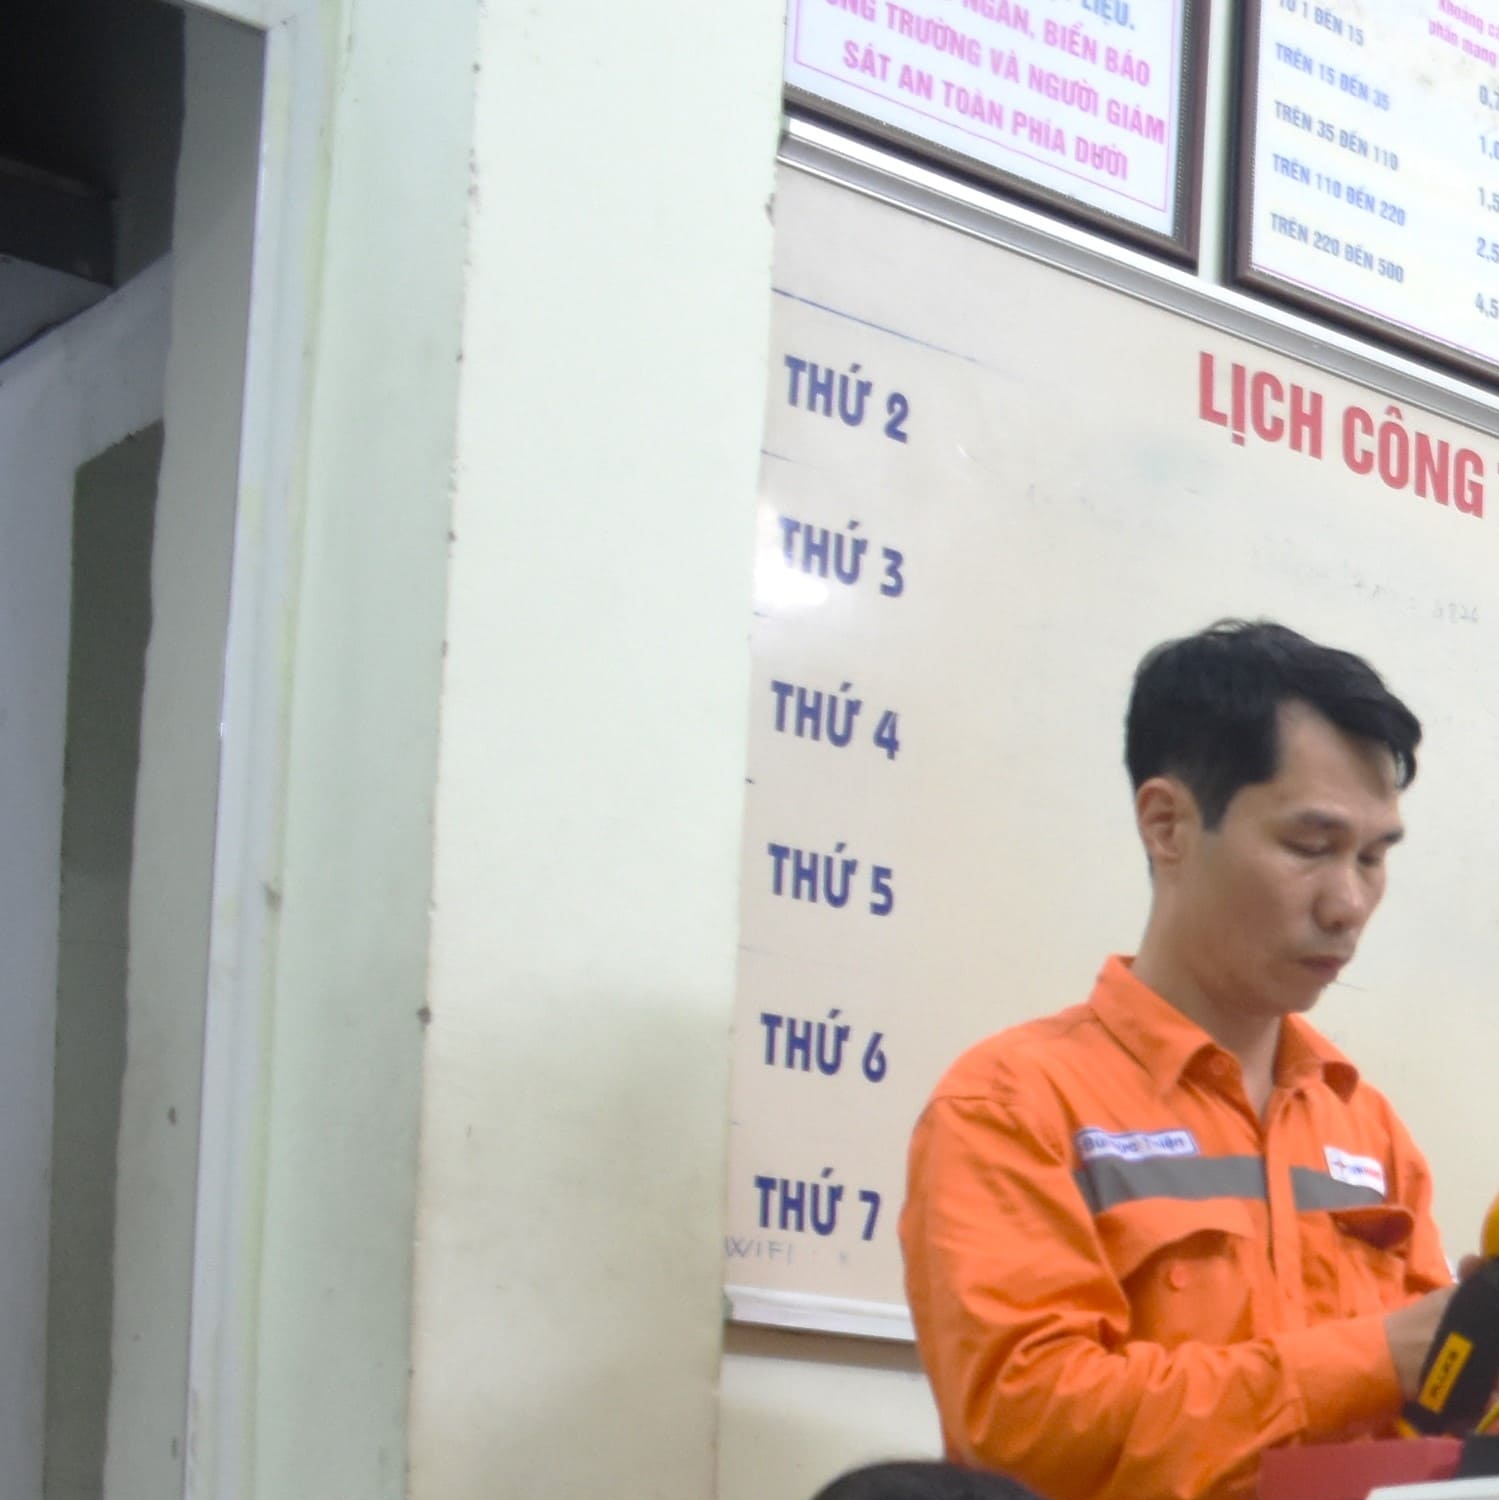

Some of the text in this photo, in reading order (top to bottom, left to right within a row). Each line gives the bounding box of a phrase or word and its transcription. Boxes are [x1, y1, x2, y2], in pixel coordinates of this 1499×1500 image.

[1105, 46, 1151, 87] BÁO
[1275, 42, 1312, 75] TRÊN
[1319, 63, 1335, 86] 15
[1348, 24, 1364, 47] 15
[843, 40, 1128, 181] SÁT AN TOÀN PHÍA DƯỚI
[885, 2, 981, 67] TRƯỜNG
[989, 48, 1020, 83] VÀ
[1028, 63, 1099, 117] NGƯỜI
[1106, 98, 1165, 145] GIÁM
[1274, 100, 1312, 132] TRÊN
[1316, 119, 1335, 143] 35
[1373, 146, 1399, 171] 110
[1272, 153, 1311, 185] TRÊN
[1316, 173, 1341, 199] 110
[1379, 200, 1406, 227] 220
[1270, 212, 1309, 244] TRÊN
[1313, 230, 1340, 257] 220
[1377, 257, 1404, 284] 500
[784, 353, 910, 444] THỨ 2
[1198, 352, 1324, 461] LỊCH
[1342, 404, 1486, 519] CÔNG
[778, 515, 905, 598] THỨ 3
[770, 679, 900, 761] THỨ 4
[767, 842, 894, 917] THỨ 5
[759, 1009, 888, 1084] THỨ 6
[754, 1167, 882, 1242] THỨ 7
